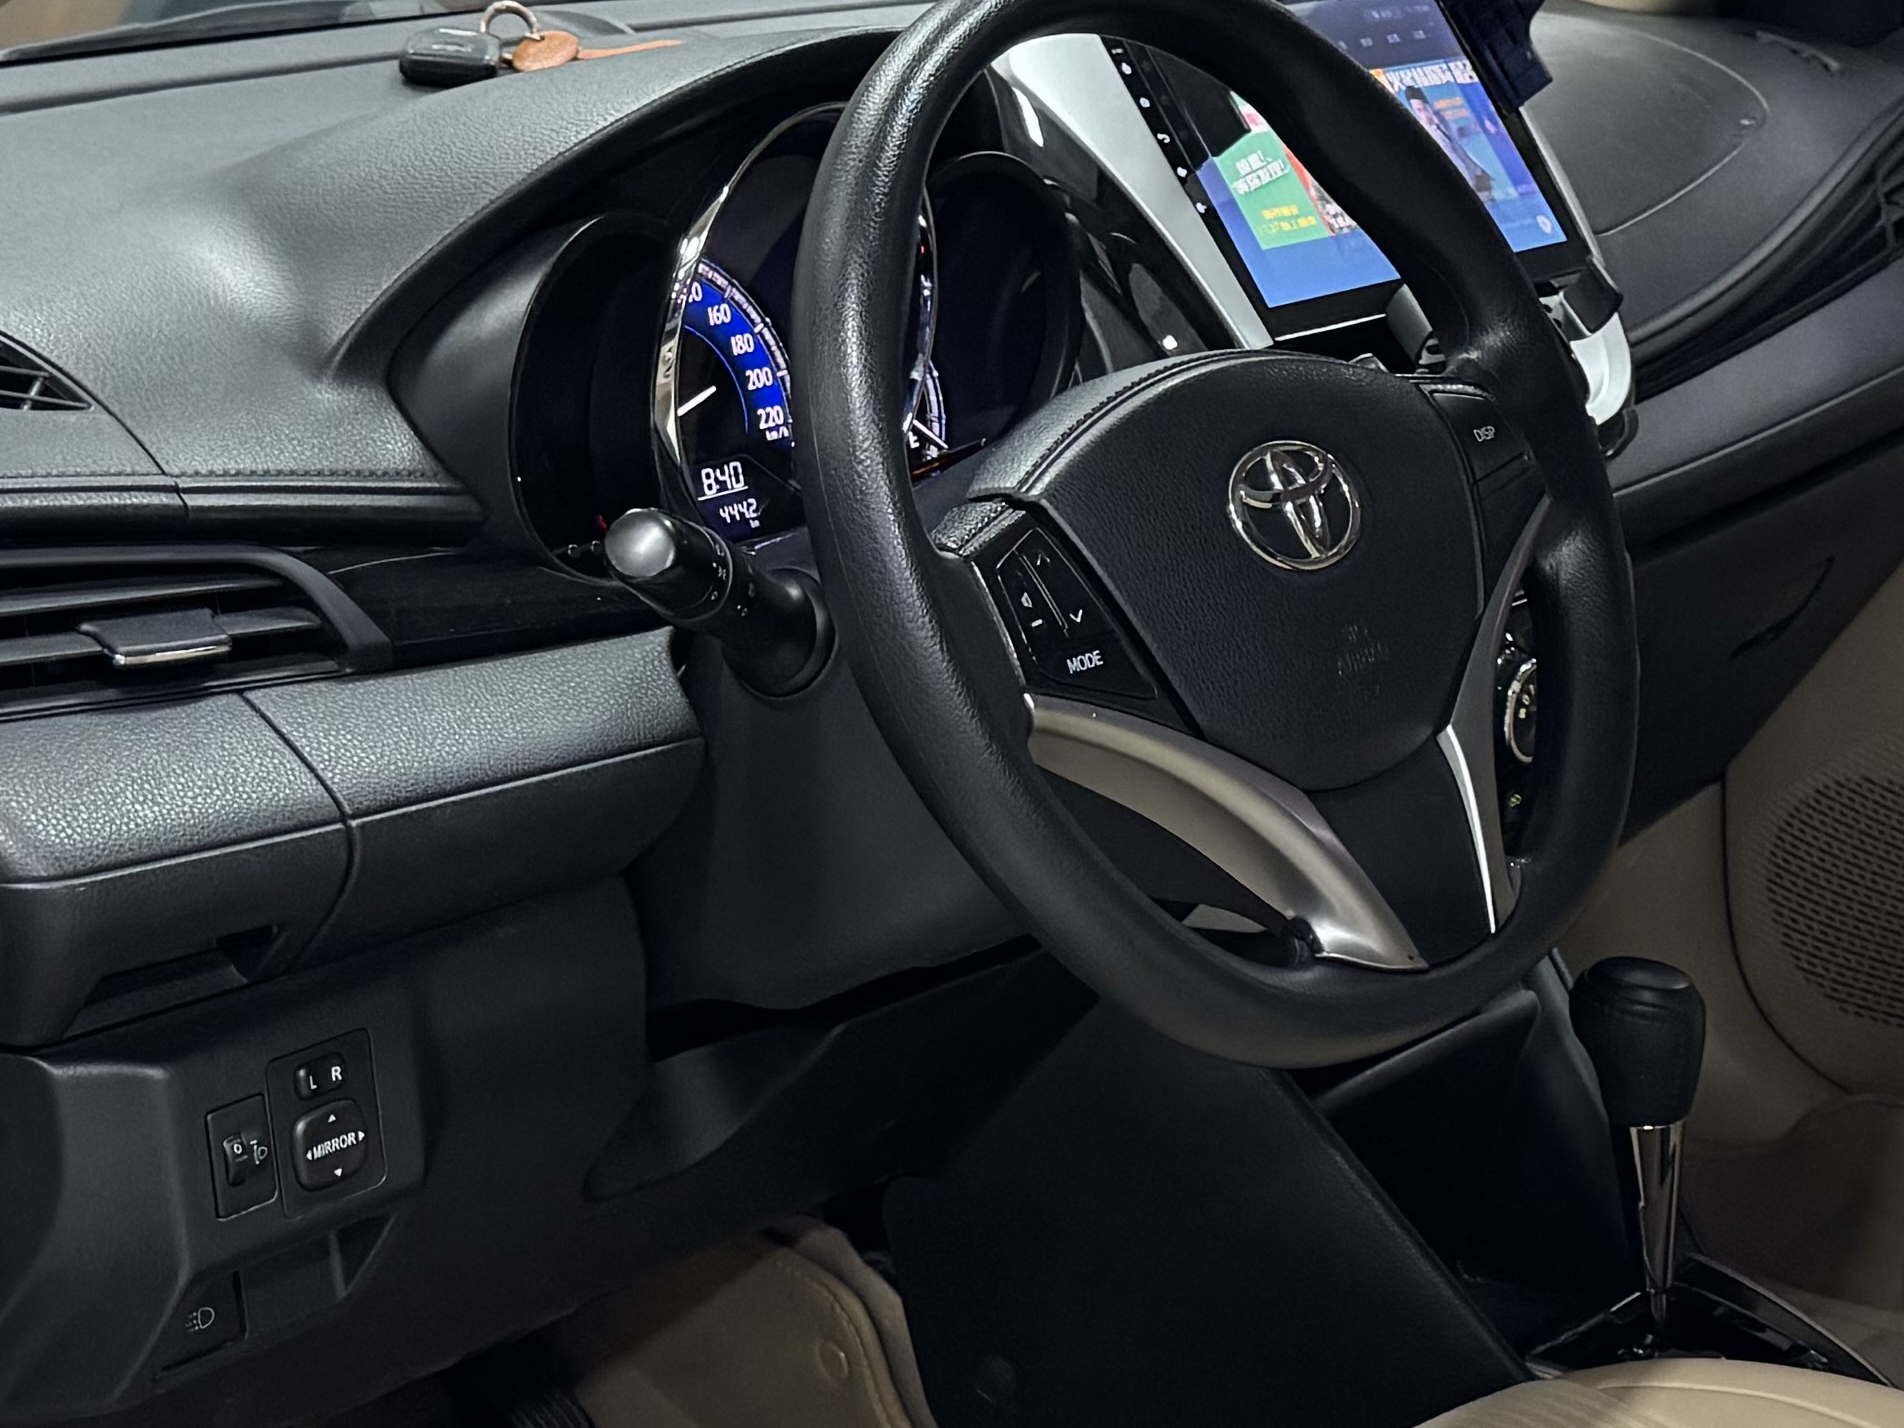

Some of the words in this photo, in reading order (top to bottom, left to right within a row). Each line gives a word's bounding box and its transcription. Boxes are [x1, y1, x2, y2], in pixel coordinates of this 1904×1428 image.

[707, 303, 731, 326] 160
[729, 333, 754, 356] 180
[745, 367, 774, 391] 200
[756, 404, 784, 429] 220
[1066, 649, 1104, 675] MODE
[308, 1075, 318, 1090] L
[330, 1065, 344, 1082] R
[312, 1131, 358, 1161] MIRROR
